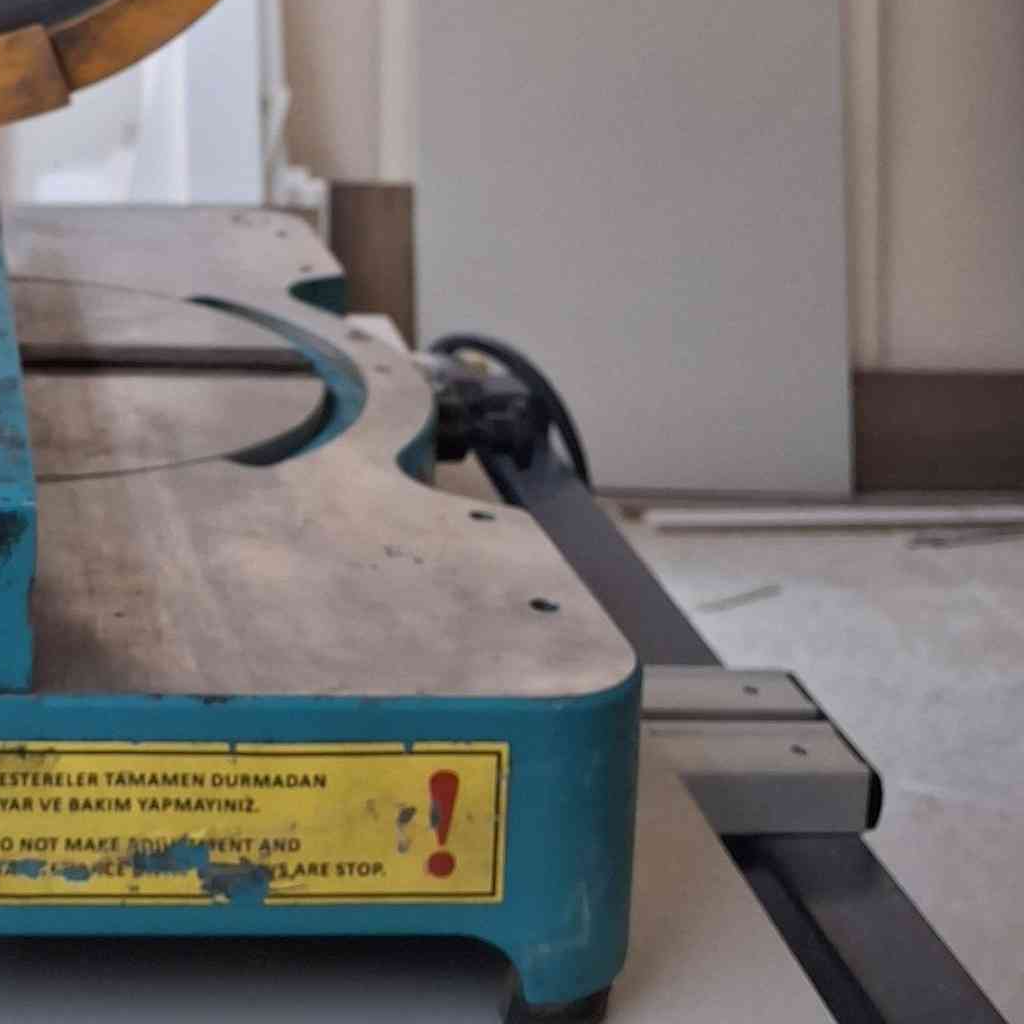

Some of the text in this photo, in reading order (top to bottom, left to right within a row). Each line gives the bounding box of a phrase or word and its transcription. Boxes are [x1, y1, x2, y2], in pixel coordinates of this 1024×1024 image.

[105, 772, 205, 787] TAMAMEN
[211, 773, 327, 789] DURMADAN
[39, 797, 63, 812] VE
[69, 797, 132, 812] BAKIM
[19, 837, 58, 852] NOT
[63, 837, 119, 852] MAKE
[259, 837, 302, 853] AND
